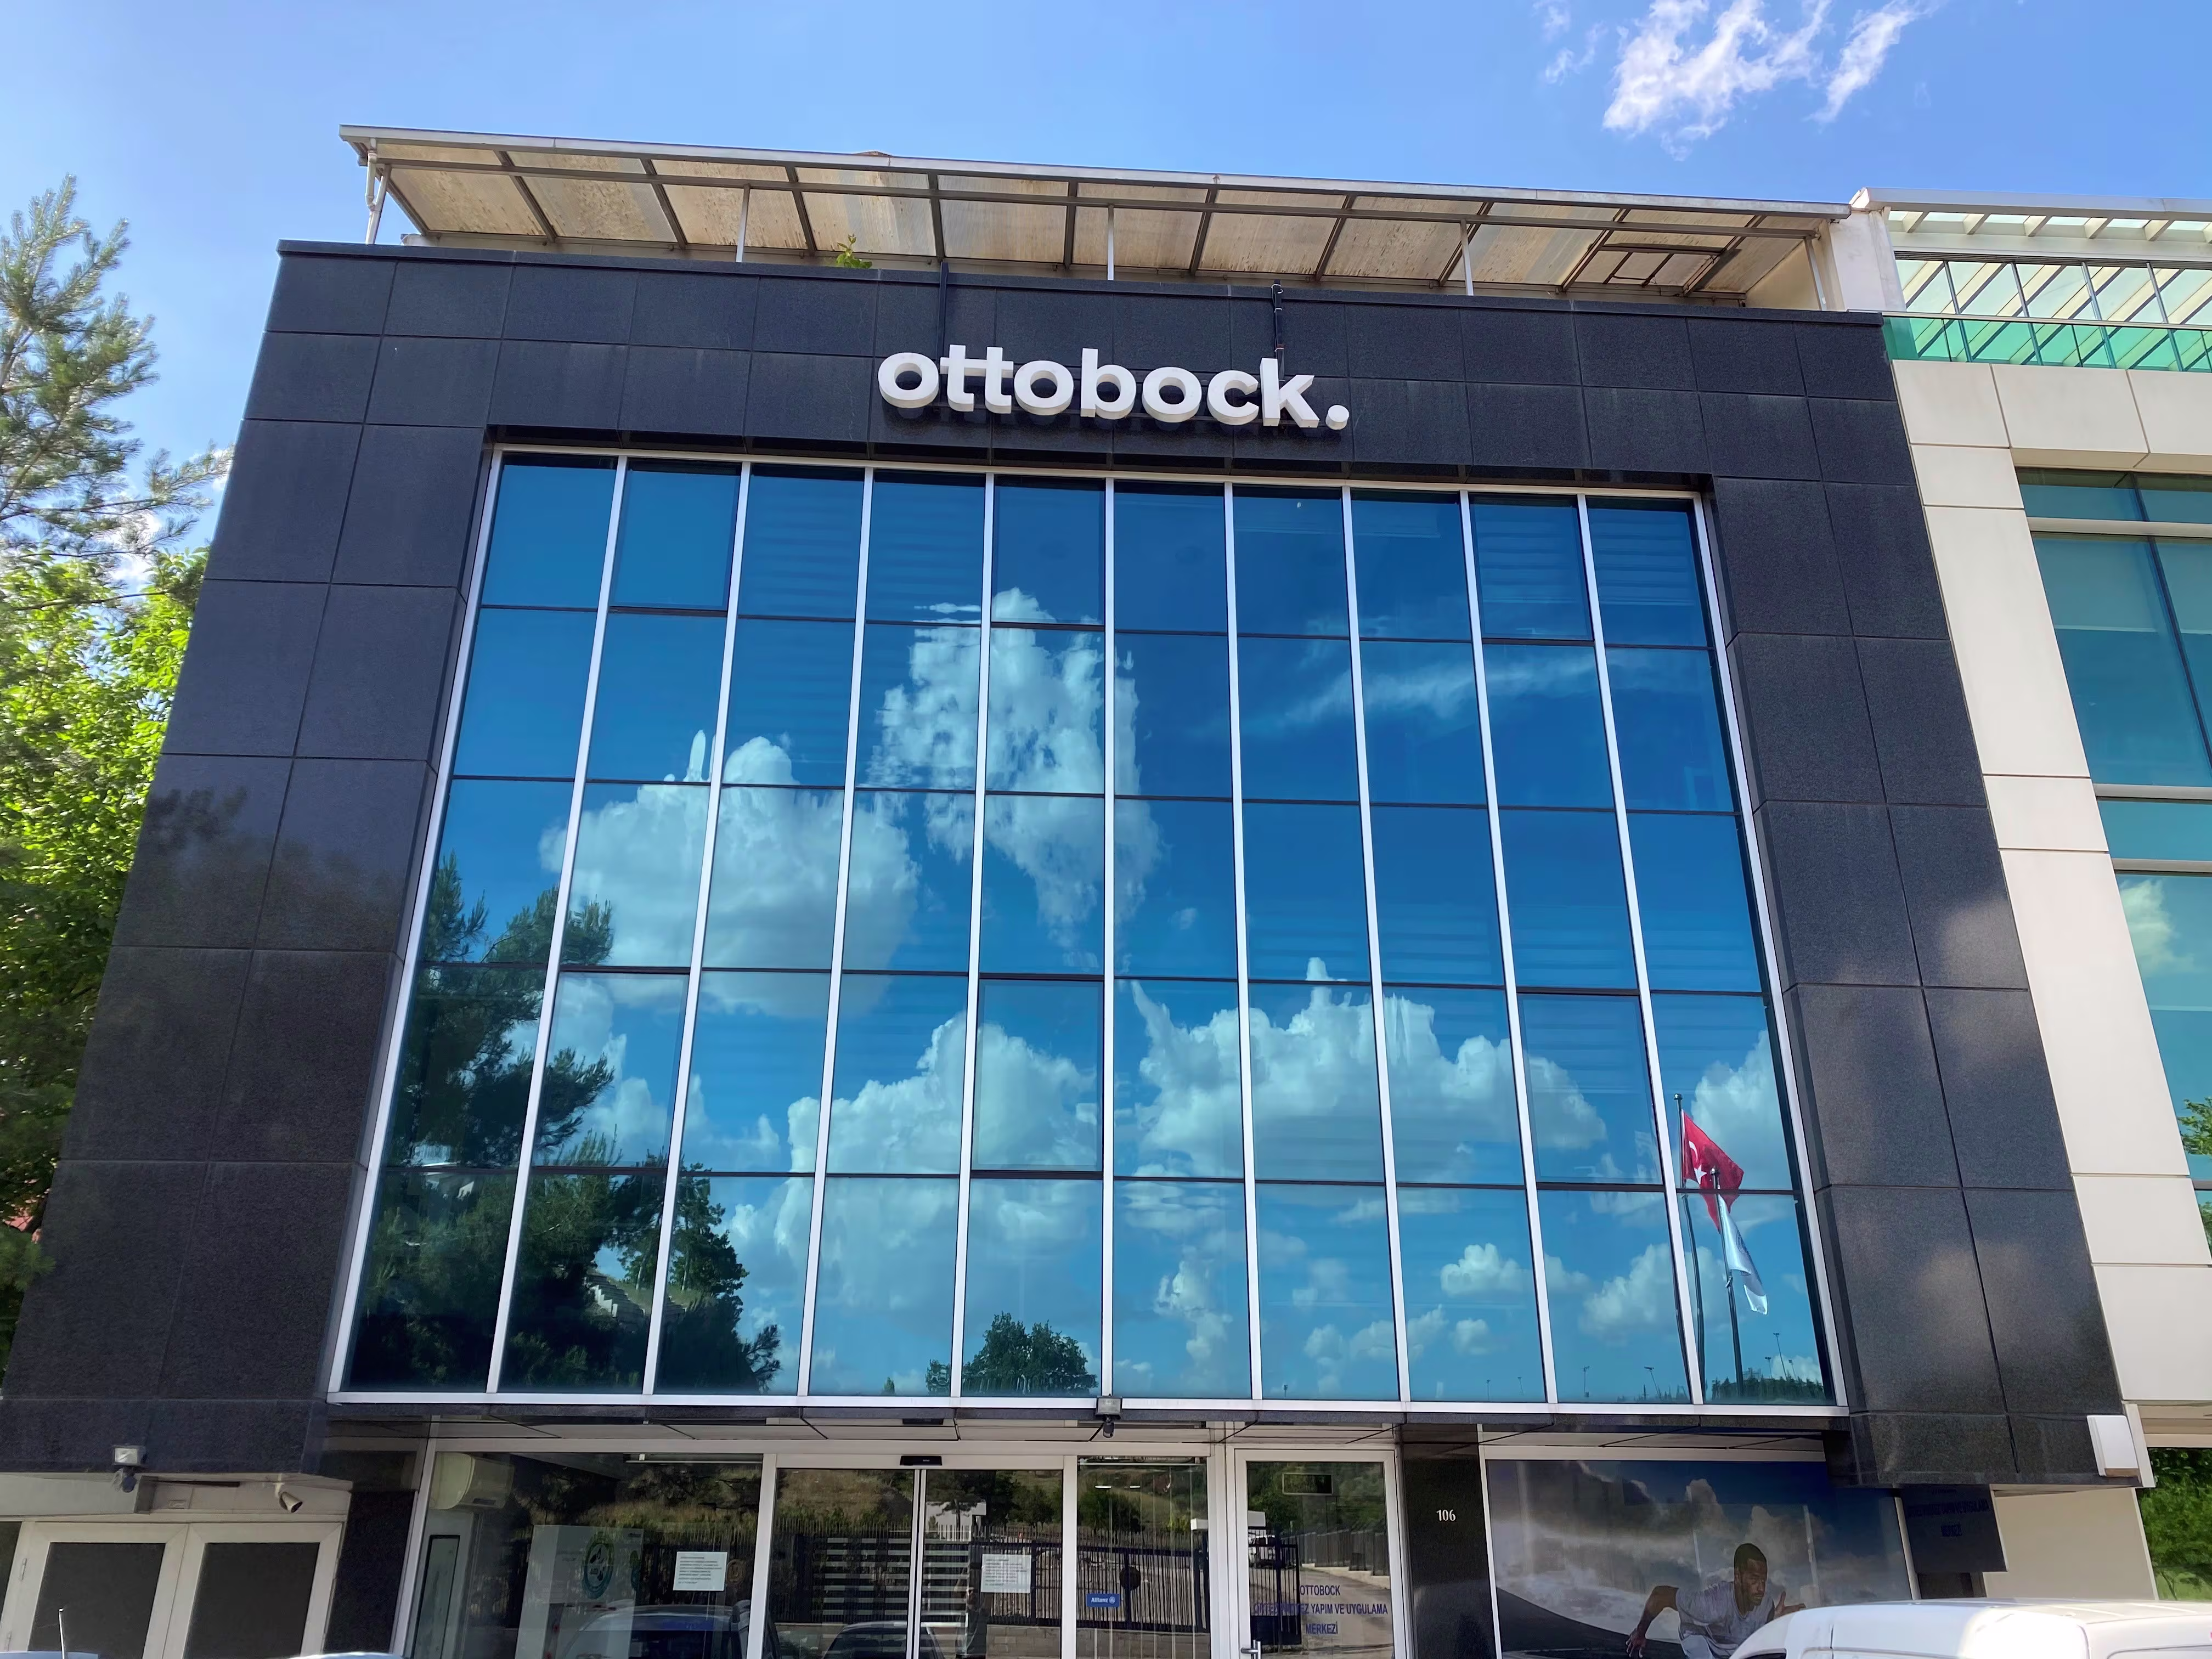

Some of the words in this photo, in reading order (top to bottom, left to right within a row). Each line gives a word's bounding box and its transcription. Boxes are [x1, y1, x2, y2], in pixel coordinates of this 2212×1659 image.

[878, 344, 1349, 431] ottobock.
[1436, 1509, 1456, 1521] 106
[1300, 1584, 1341, 1596] OTTOBOCK
[1311, 1603, 1333, 1615] YAPIM
[1335, 1603, 1345, 1615] VE
[1346, 1603, 1388, 1615] UYGULAMA
